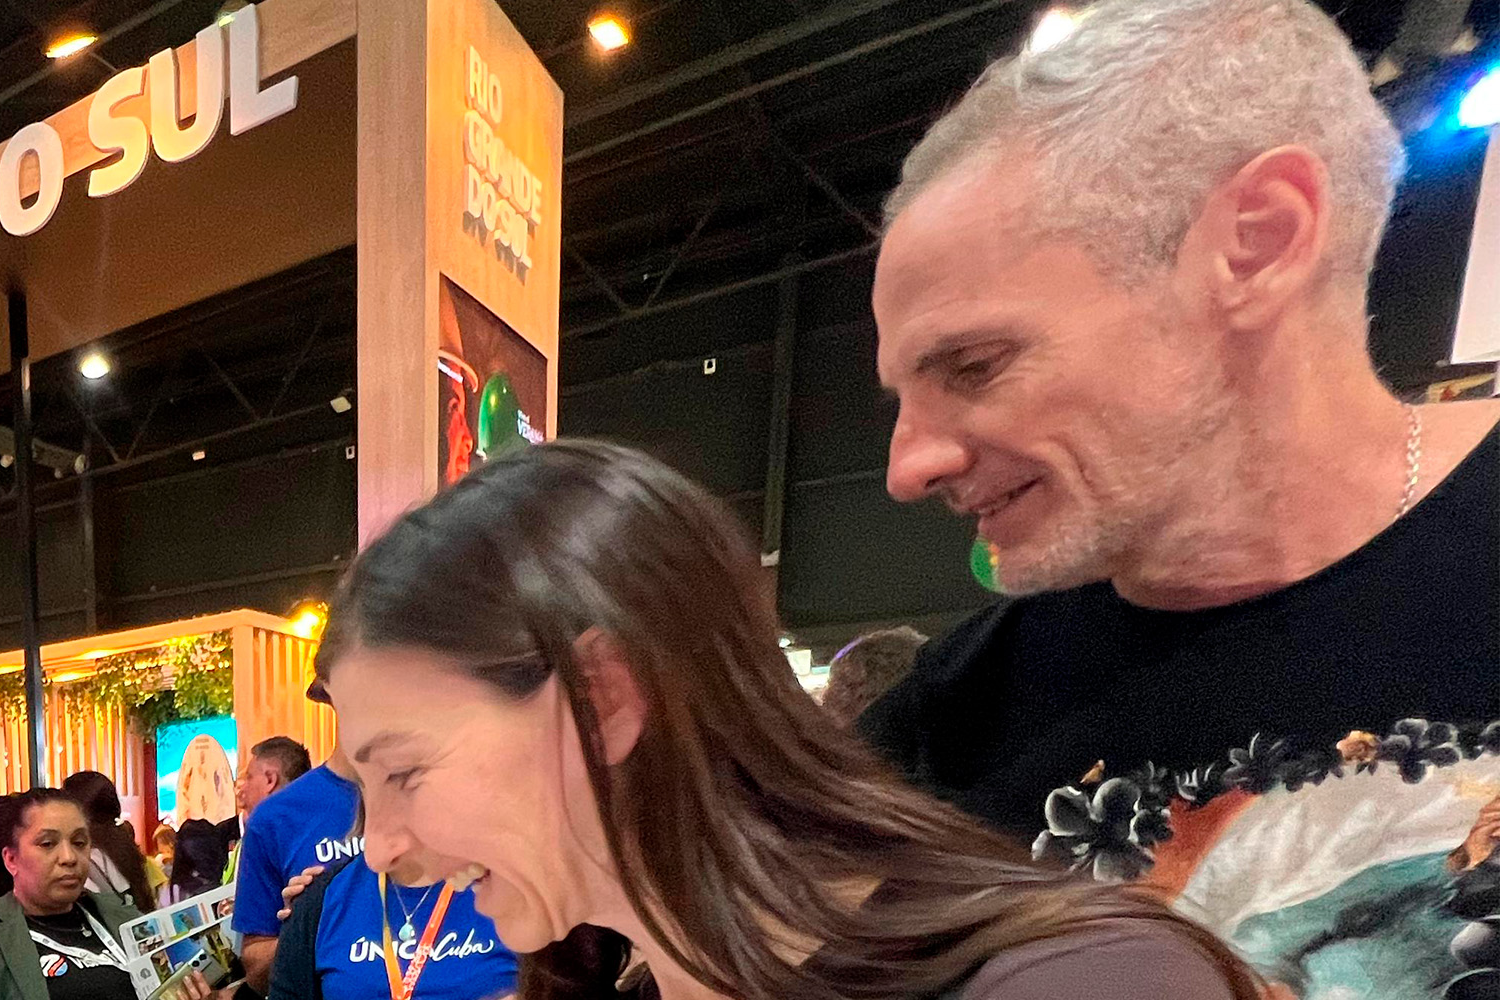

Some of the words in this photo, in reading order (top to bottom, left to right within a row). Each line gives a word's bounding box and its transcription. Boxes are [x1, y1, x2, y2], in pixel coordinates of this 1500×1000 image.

[88, 4, 299, 197] SUL
[467, 45, 503, 124] RIO
[464, 109, 542, 227] GRANDE
[466, 163, 498, 233] DO
[494, 199, 532, 269] SUL
[349, 936, 435, 962] ÚNIC
[431, 928, 494, 962] Cuba
